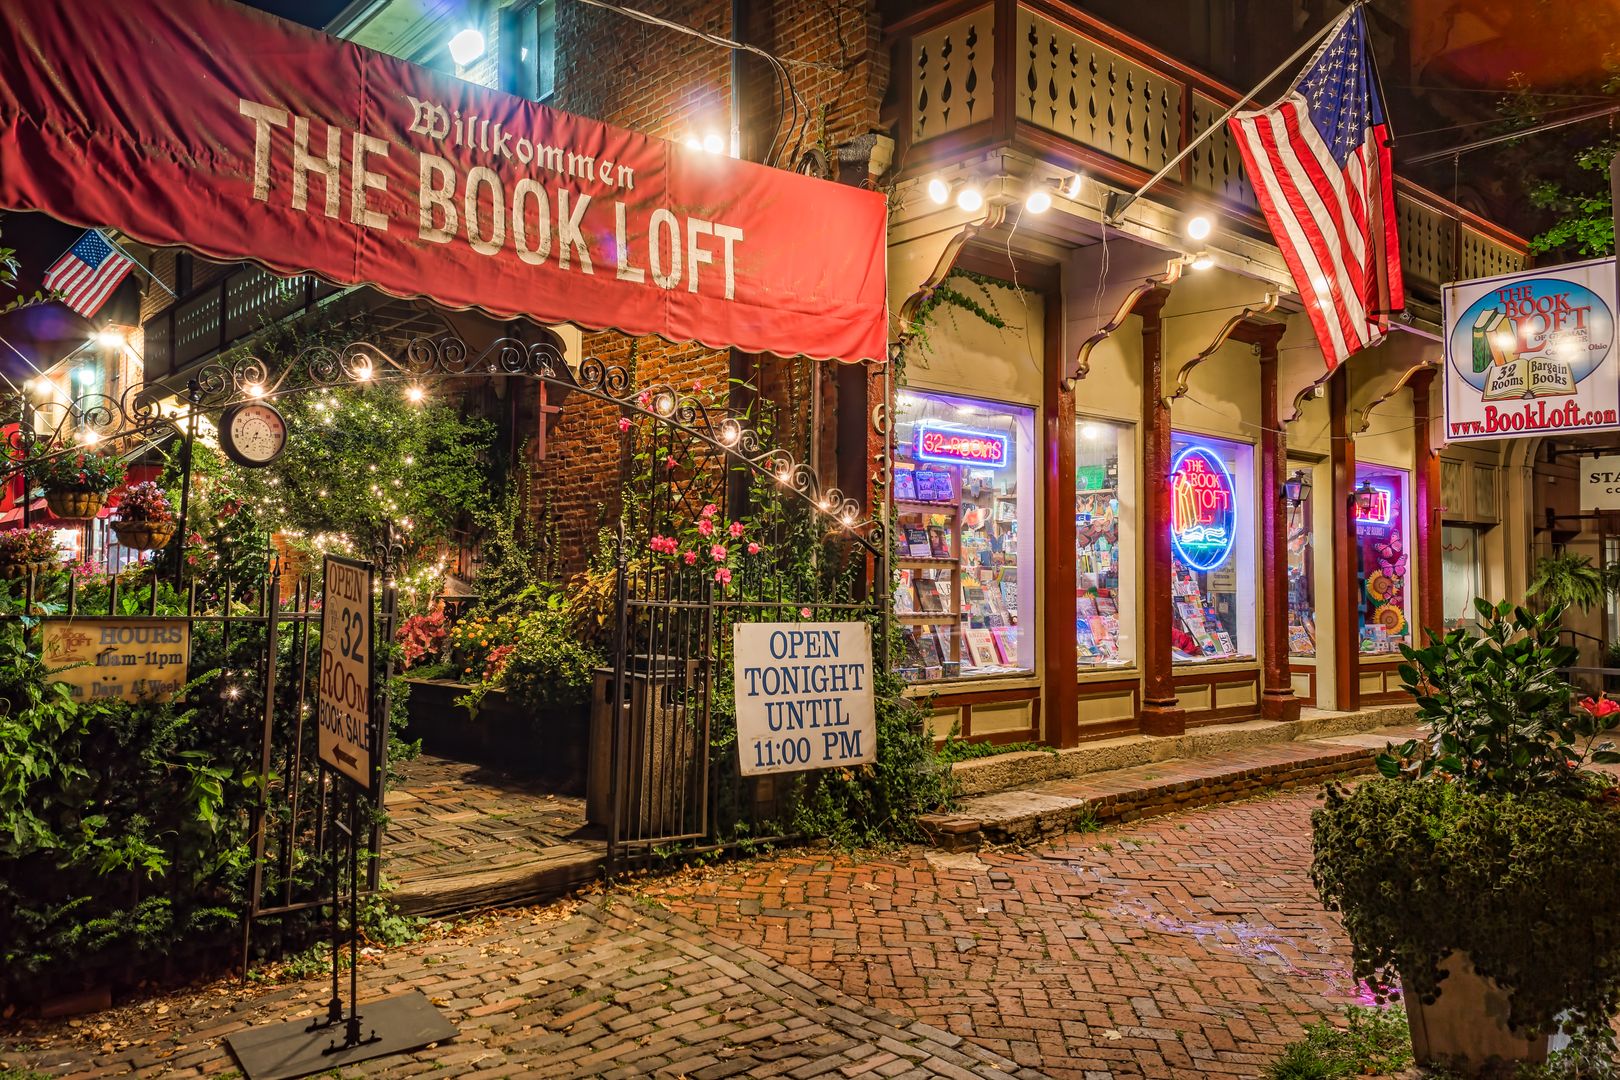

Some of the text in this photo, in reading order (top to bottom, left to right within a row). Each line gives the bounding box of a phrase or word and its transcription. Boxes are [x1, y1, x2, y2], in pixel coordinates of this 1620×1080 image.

[407, 95, 635, 192] Willkommen
[239, 98, 745, 301] THE BOOK LOFT
[1496, 285, 1533, 304] THE
[1504, 293, 1571, 318] BOOK
[1510, 305, 1592, 355] LOFT
[1588, 343, 1608, 351] Ohio
[1497, 363, 1517, 381] 32
[1531, 360, 1568, 375] Bargain
[1532, 373, 1568, 386] Books
[1491, 376, 1524, 391] Rooms
[1450, 399, 1617, 435] www.BookLoft.com
[923, 432, 943, 454] 32
[1185, 459, 1205, 473] THE
[1191, 473, 1220, 489] BOOK
[1195, 489, 1229, 522] LOFT
[329, 563, 365, 604] OPEN
[64, 637, 93, 653] LOFT
[98, 624, 183, 645] HOURS
[341, 607, 364, 664] 32
[770, 630, 840, 660] OPEN
[744, 663, 864, 696] TONIGHT
[320, 697, 344, 738] BOOK
[765, 698, 849, 732] UNTIL
[345, 713, 369, 752] SALE
[754, 729, 863, 767] 11:00 PM
